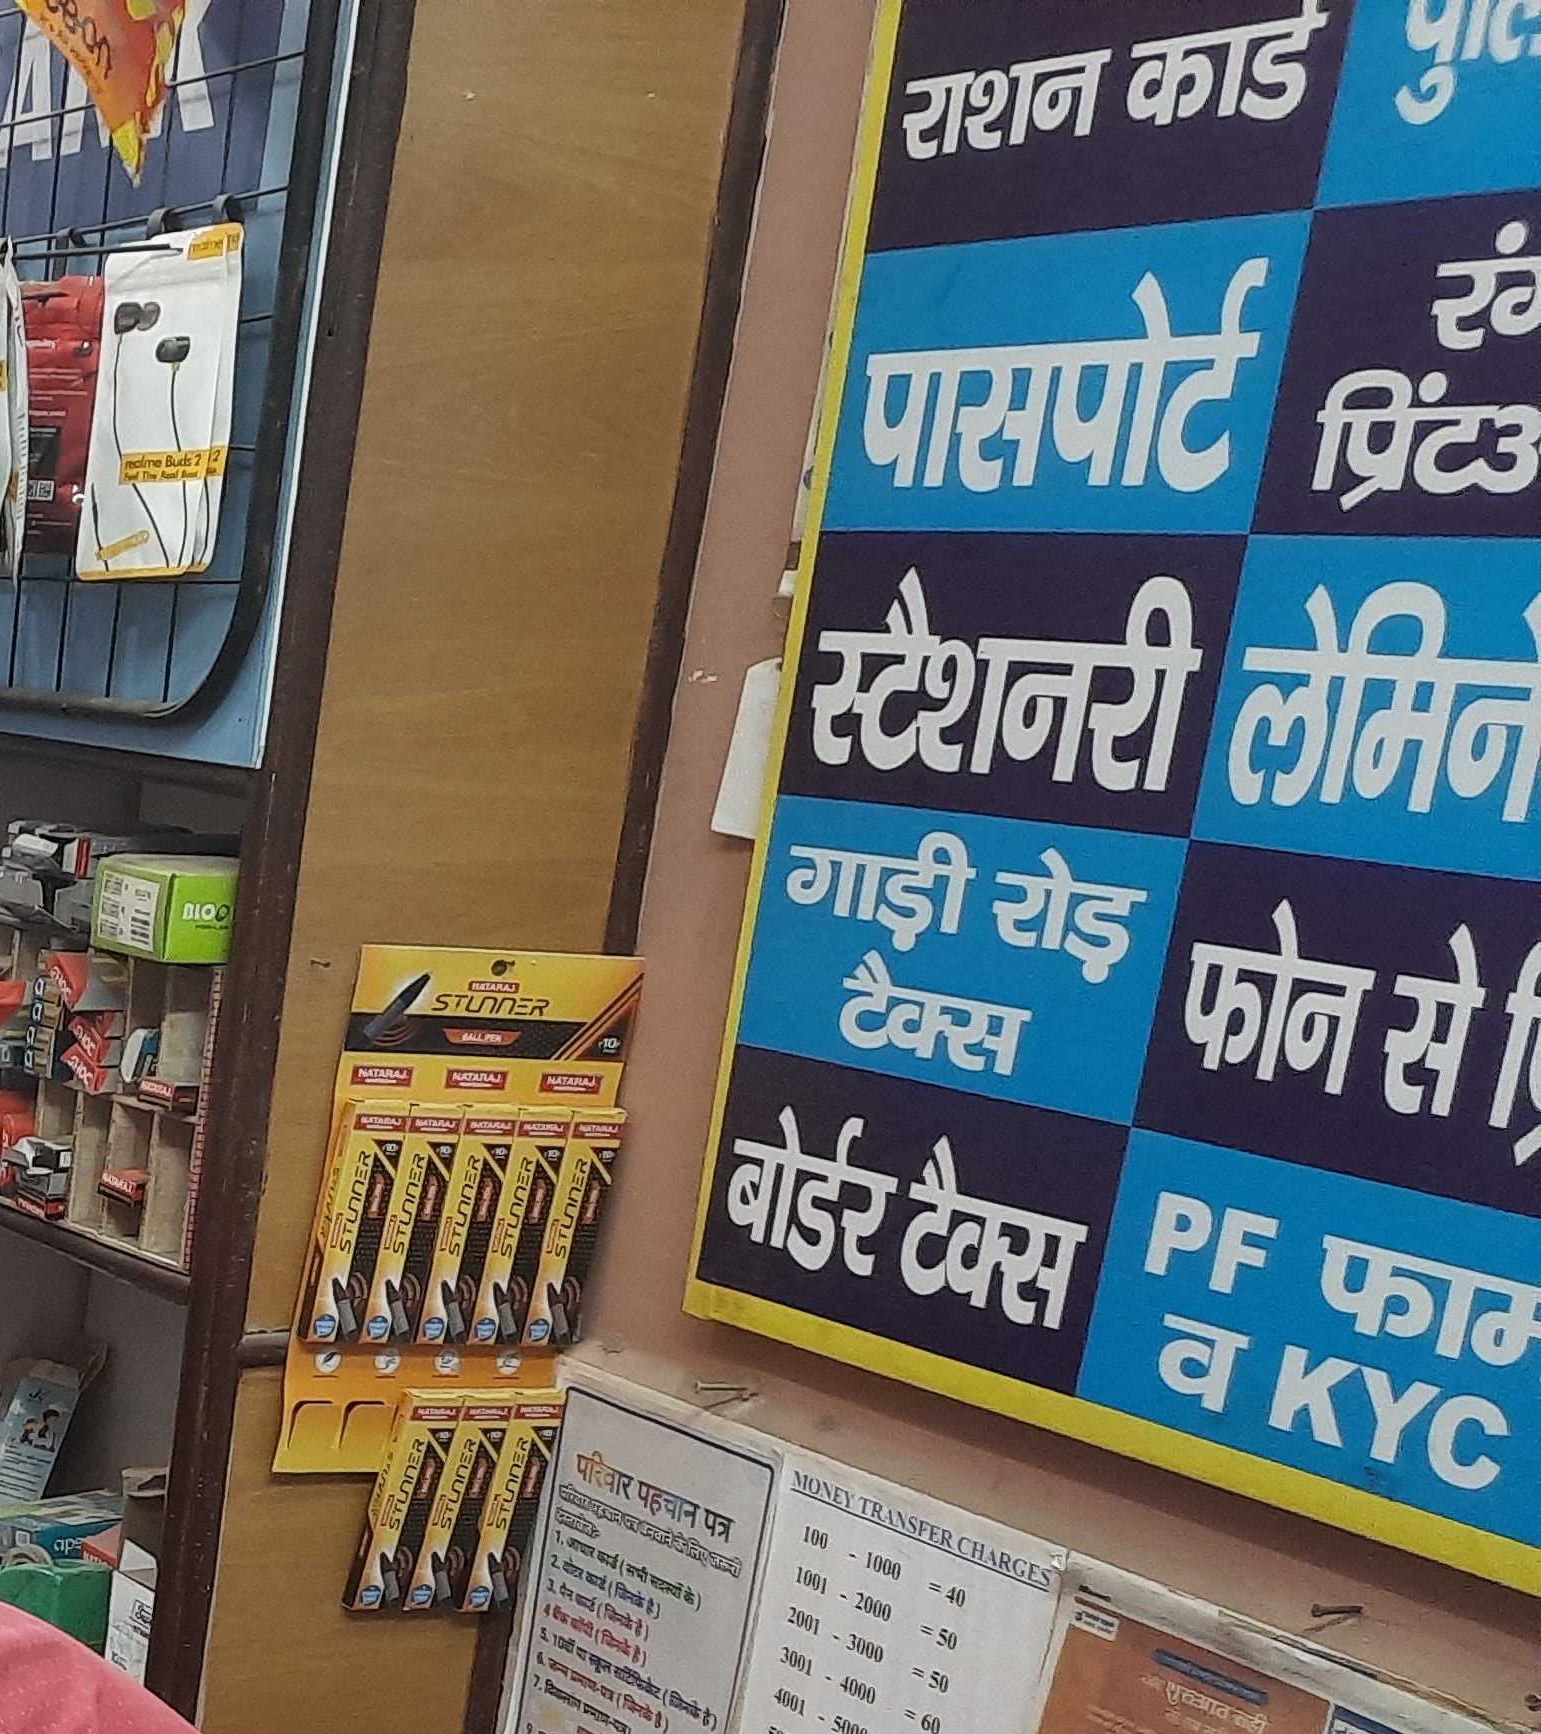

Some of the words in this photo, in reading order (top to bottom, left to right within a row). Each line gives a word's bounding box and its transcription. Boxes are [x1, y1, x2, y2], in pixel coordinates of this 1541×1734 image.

[901, 48, 1111, 161] राशन
[1126, 0, 1329, 127] कार्ड
[862, 256, 1271, 493] पासपोर्ट
[124, 456, 162, 471] realme
[165, 453, 192, 468] Buds
[786, 831, 978, 951] गाड़ी
[432, 993, 550, 1017] STUNNER
[471, 981, 517, 993] NATARAJ
[838, 949, 1031, 1077] टैक्स
[1184, 899, 1377, 1095] फोन
[1382, 922, 1485, 1118] से
[357, 1066, 408, 1080] NATARAJ
[451, 1070, 503, 1084] NATARAJ
[547, 1074, 596, 1088] NATARAJ
[339, 1150, 372, 1255] STUNNER
[392, 1152, 428, 1255] STUNNER
[448, 1154, 482, 1257] STUNNER
[501, 1156, 534, 1257] STUNNER
[555, 1158, 589, 1259] STUNNER
[725, 1104, 898, 1277] बोर्डर
[899, 1135, 1089, 1332] टैक्स
[1143, 1190, 1278, 1293] PF
[1157, 1312, 1249, 1412] व
[1268, 1343, 1510, 1490] KYC
[388, 1437, 426, 1531] STUNNER
[440, 1437, 478, 1530] STUNNER
[495, 1435, 530, 1530] STUNNER
[576, 1450, 635, 1501] परिवार
[636, 1479, 701, 1529] पहचान
[703, 1507, 736, 1544] पत्र
[791, 1468, 856, 1511] MONEY
[856, 1493, 954, 1555] TRANSFER
[956, 1534, 1052, 1588] CHARGES
[794, 1565, 828, 1596] 1001
[854, 1590, 893, 1623] 2000
[935, 1628, 958, 1651] 50
[801, 1525, 829, 1551] 100
[865, 1549, 903, 1582] 1000
[945, 1586, 967, 1608] 40
[779, 1646, 814, 1678] 3001
[839, 1673, 877, 1705] 4000
[786, 1606, 821, 1638] 2001
[845, 1632, 884, 1664] 3000
[927, 1671, 950, 1694] 50
[772, 1687, 807, 1718] 4001
